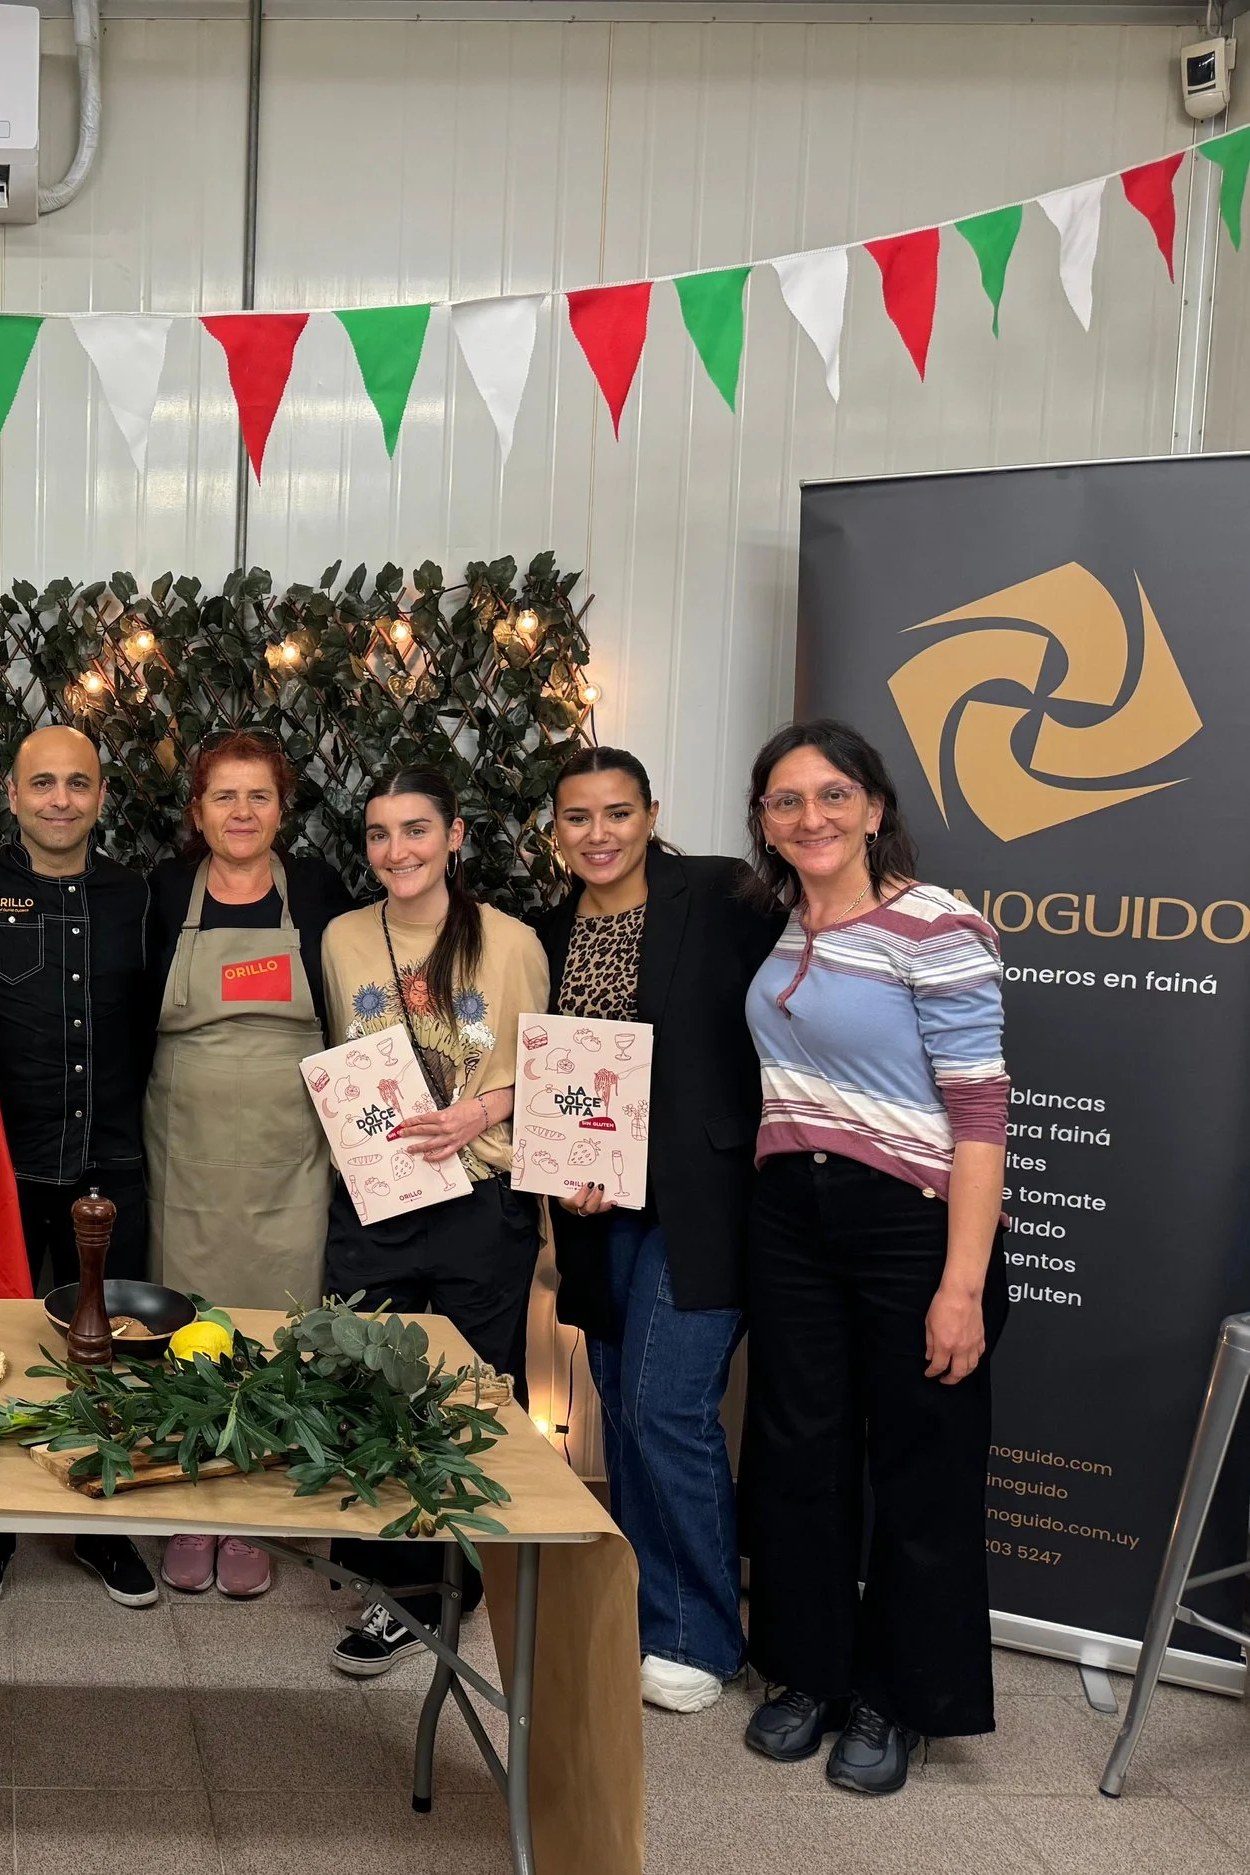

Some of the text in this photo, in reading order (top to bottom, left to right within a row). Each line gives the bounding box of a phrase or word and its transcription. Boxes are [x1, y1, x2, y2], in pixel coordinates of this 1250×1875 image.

[953, 888, 1250, 944] NOGUIDO
[225, 960, 278, 979] ORILLO
[1000, 962, 1217, 994] ioneros en fainá
[554, 1094, 601, 1107] DOLCE
[568, 1085, 586, 1096] LA
[1010, 1088, 1106, 1112] blancas
[356, 1107, 396, 1129] DOLCE
[362, 1104, 380, 1116] LA
[559, 1105, 593, 1117] VITA
[363, 1120, 395, 1136] VITA
[1005, 1123, 1111, 1146] ara fainá
[1006, 1151, 1047, 1172] ites
[399, 1189, 423, 1201] ORILLO
[1019, 1186, 1106, 1211] tomate
[1008, 1283, 1082, 1306] gluten
[989, 1445, 1112, 1476] noguido.com
[986, 1472, 1068, 1500] inoguido
[985, 1504, 1140, 1550] noguido.com.uy
[1018, 1545, 1062, 1565] 5247
